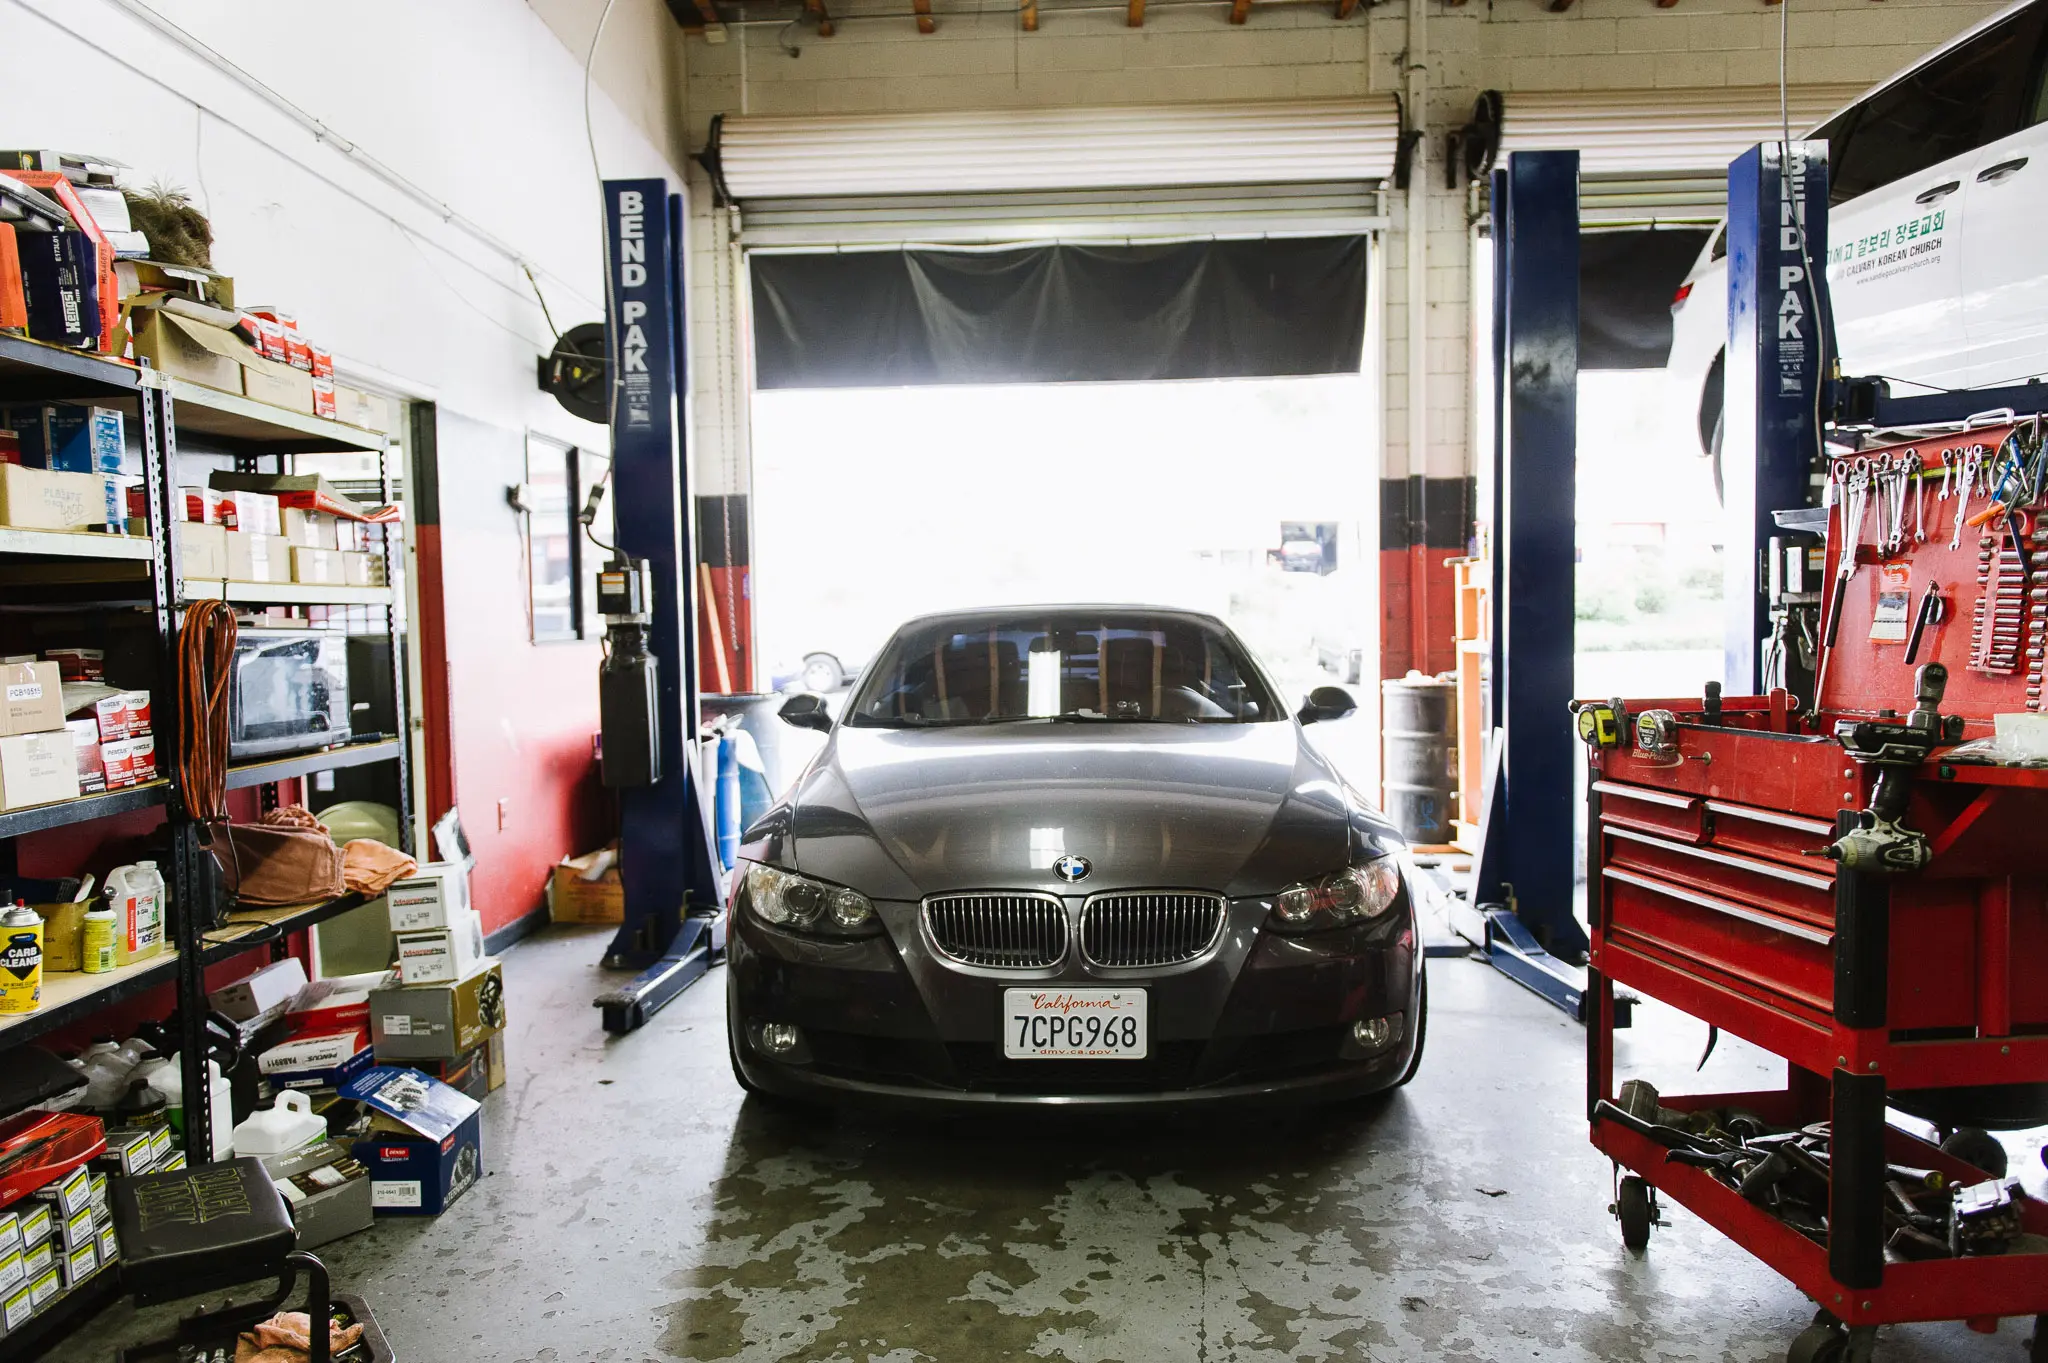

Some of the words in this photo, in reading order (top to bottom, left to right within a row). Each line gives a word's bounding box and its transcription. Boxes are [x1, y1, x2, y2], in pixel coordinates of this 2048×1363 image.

[619, 191, 647, 287] BEND
[1895, 209, 1946, 245] 장로교회
[1846, 259, 1876, 277] CALVARY
[1878, 249, 1908, 267] KOREAN
[1909, 237, 1943, 257] CHURCH
[60, 289, 81, 334] Hengst
[1778, 266, 1804, 339] PAK
[623, 301, 648, 372] PAK
[8, 947, 37, 958] CARB
[1034, 993, 1120, 1014] California
[1014, 1016, 1137, 1048] 7CPG968
